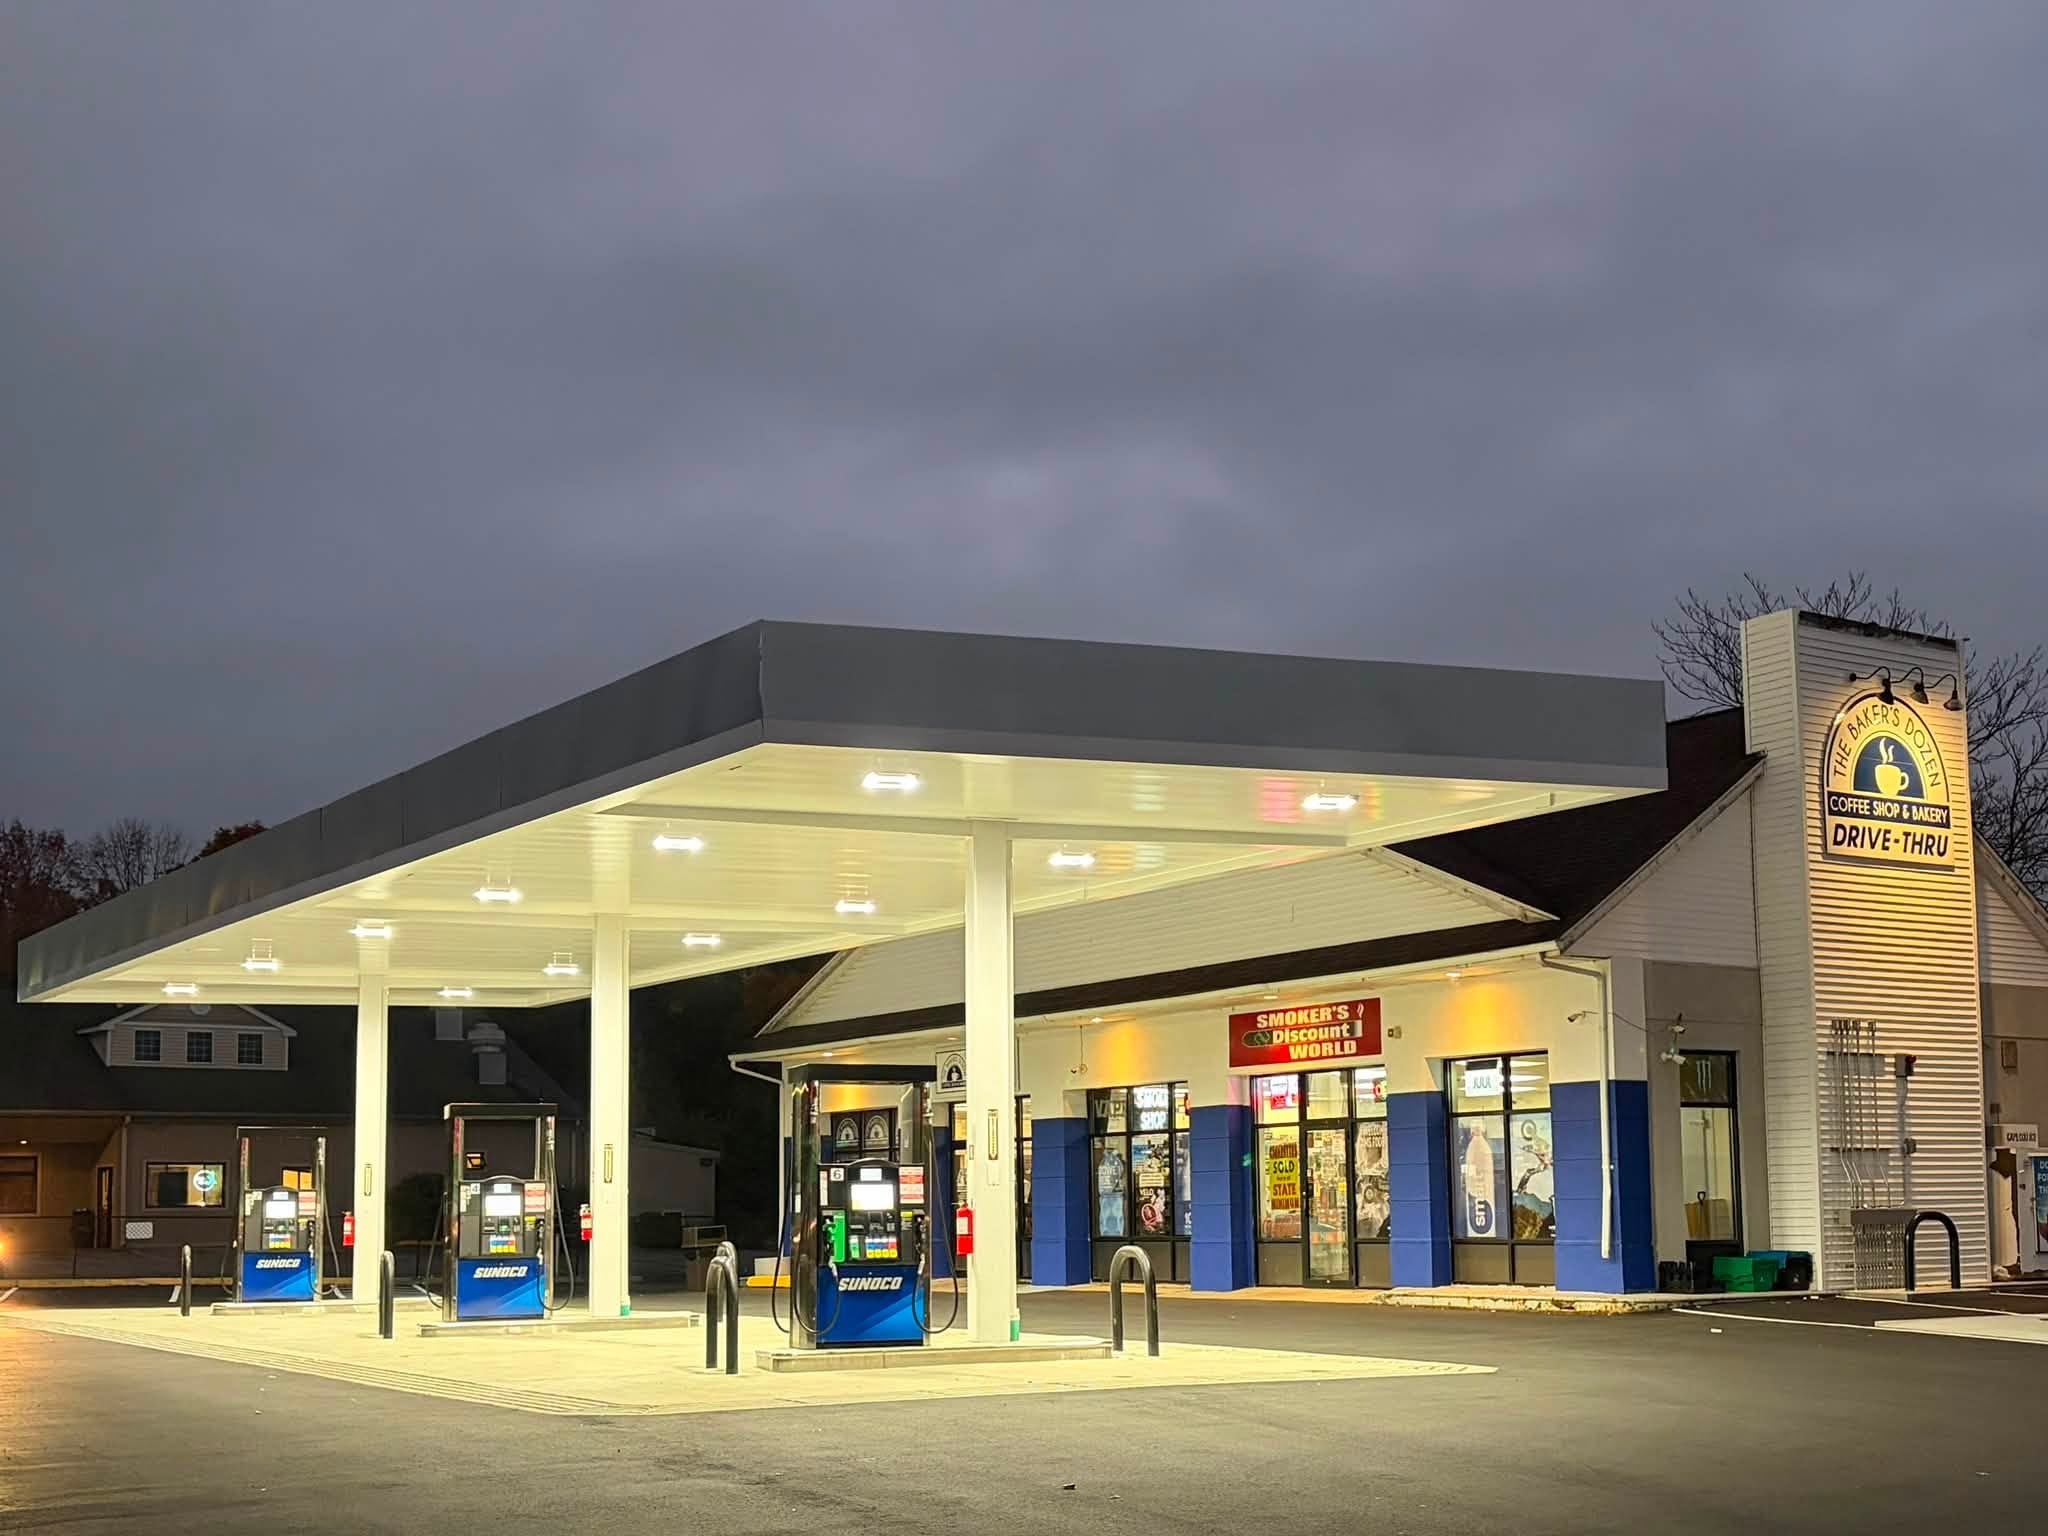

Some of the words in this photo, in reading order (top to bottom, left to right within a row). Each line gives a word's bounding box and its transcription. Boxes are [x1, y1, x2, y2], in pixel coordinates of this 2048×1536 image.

[1833, 738, 1852, 777] THE
[1847, 703, 1900, 740] BAKER'S
[1904, 718, 1941, 787] DOZEN
[1830, 796, 1871, 815] COFFEE
[1873, 801, 1900, 818] SHOP
[1902, 804, 1910, 819] &
[1912, 805, 1948, 823] BAKERY
[1832, 823, 1949, 857] DRIVE-THRU
[1256, 1004, 1350, 1028] SMOKER'S
[1272, 1023, 1350, 1044] Discount
[1288, 1040, 1357, 1060] WORLD
[833, 1170, 842, 1180] 6
[1273, 1159, 1295, 1174] SOLD
[1273, 1183, 1297, 1196] STATE
[256, 1258, 301, 1269] SUNOCO
[473, 1266, 529, 1278] SUNOCO
[838, 1276, 903, 1291] SUNOCO
